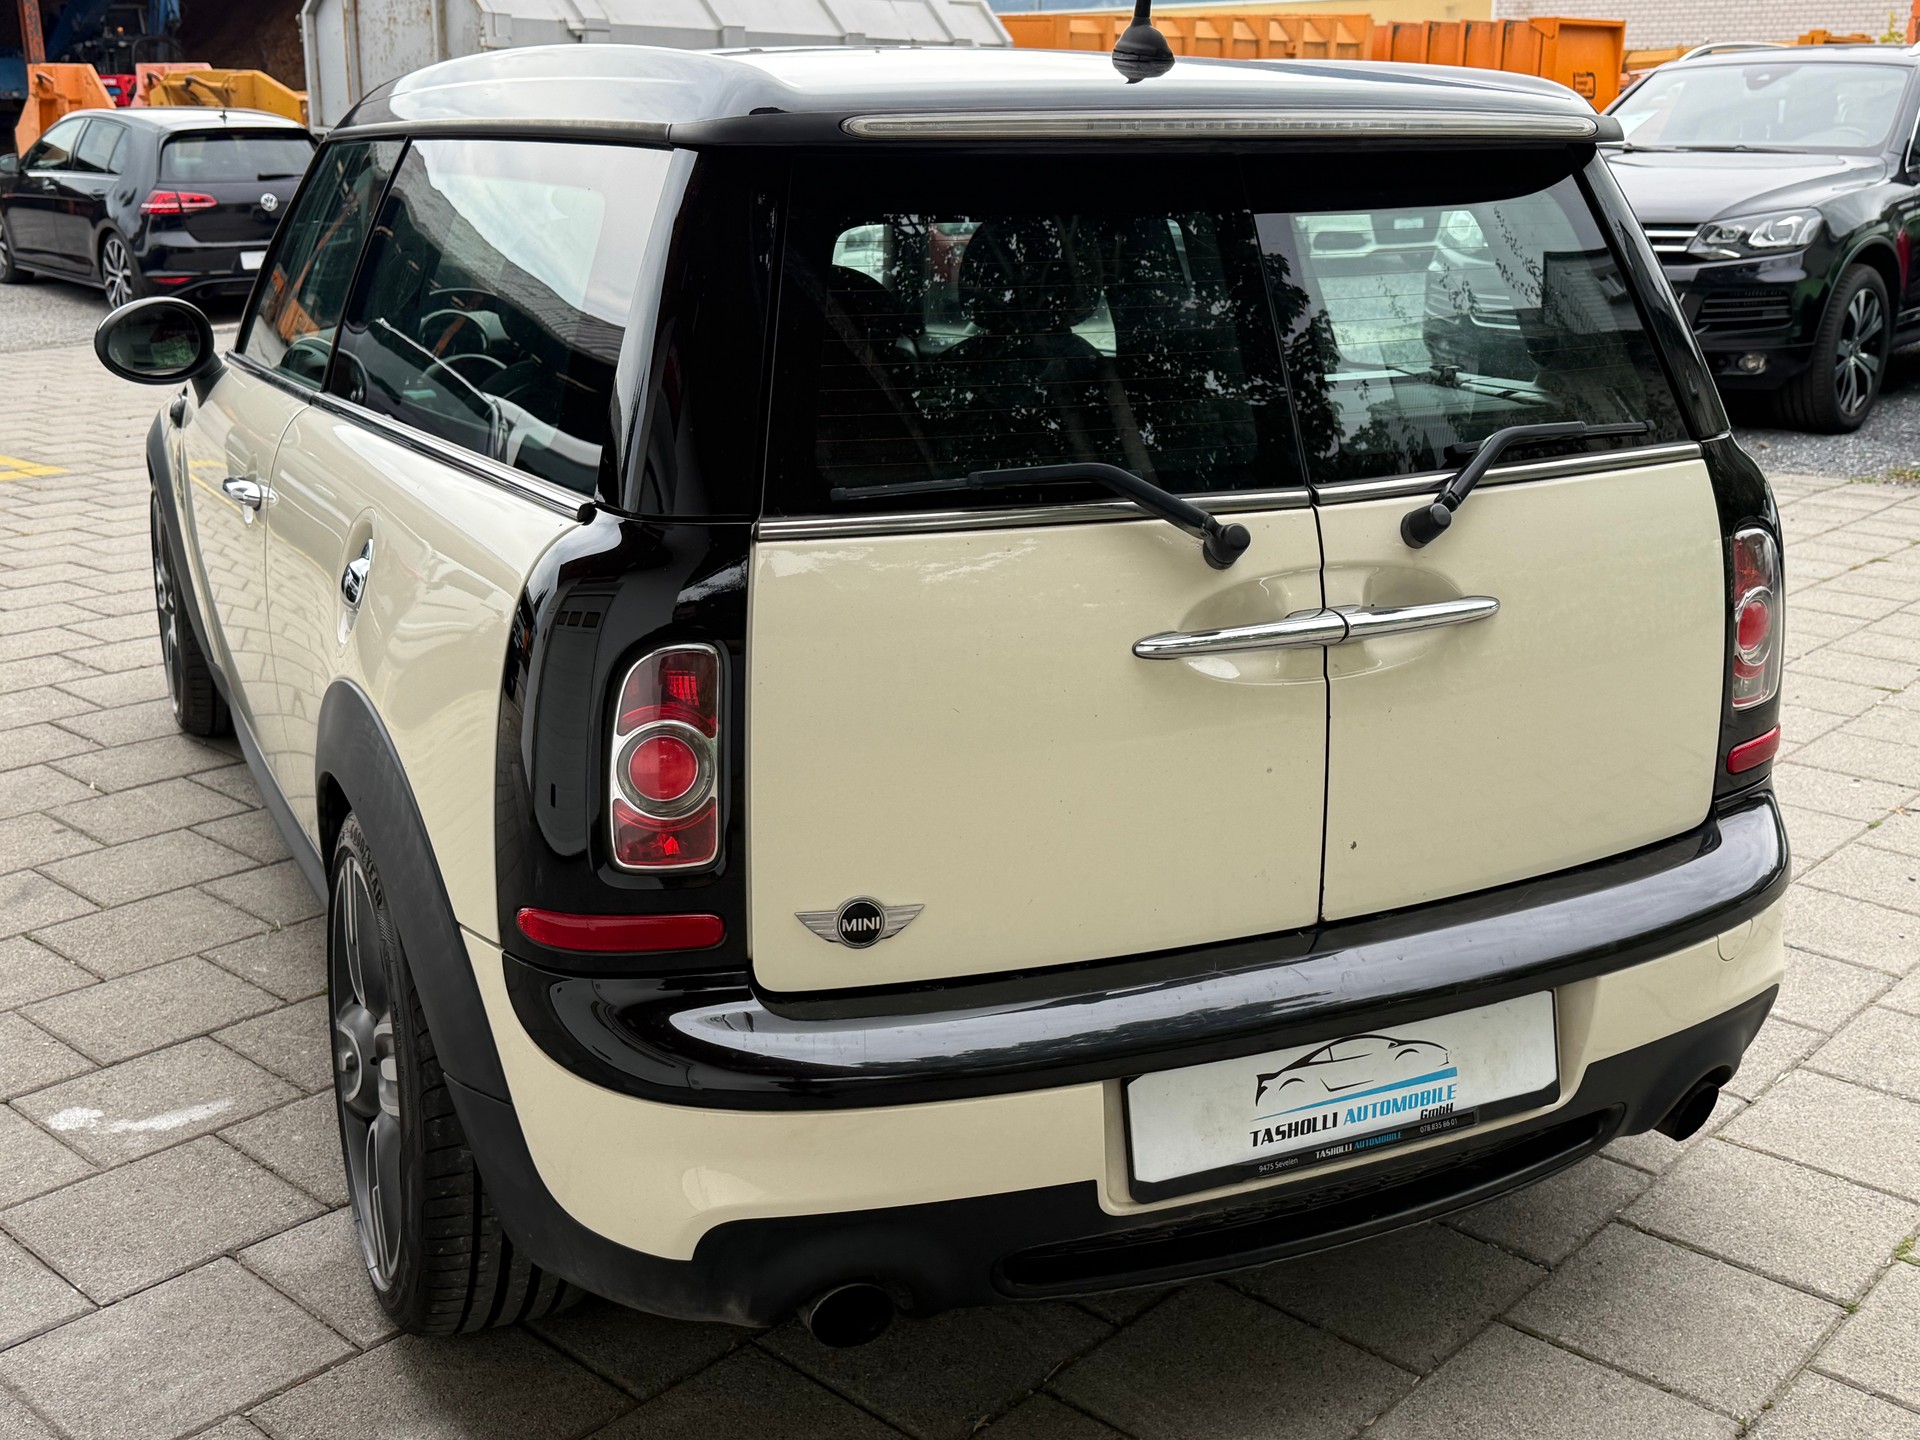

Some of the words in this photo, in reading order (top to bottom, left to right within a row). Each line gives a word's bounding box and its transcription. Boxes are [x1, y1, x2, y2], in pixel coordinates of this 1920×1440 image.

[842, 916, 880, 932] MINI
[1250, 1112, 1338, 1147] TASHOLLI
[1343, 1084, 1457, 1125] AUTOMOBILE
[1420, 1103, 1454, 1119] GmbH
[1316, 1143, 1353, 1159] TASHOLLI
[1354, 1131, 1402, 1150] AUTOMOBILE
[1258, 1163, 1274, 1173] 9475
[1275, 1158, 1299, 1169] Sevelen
